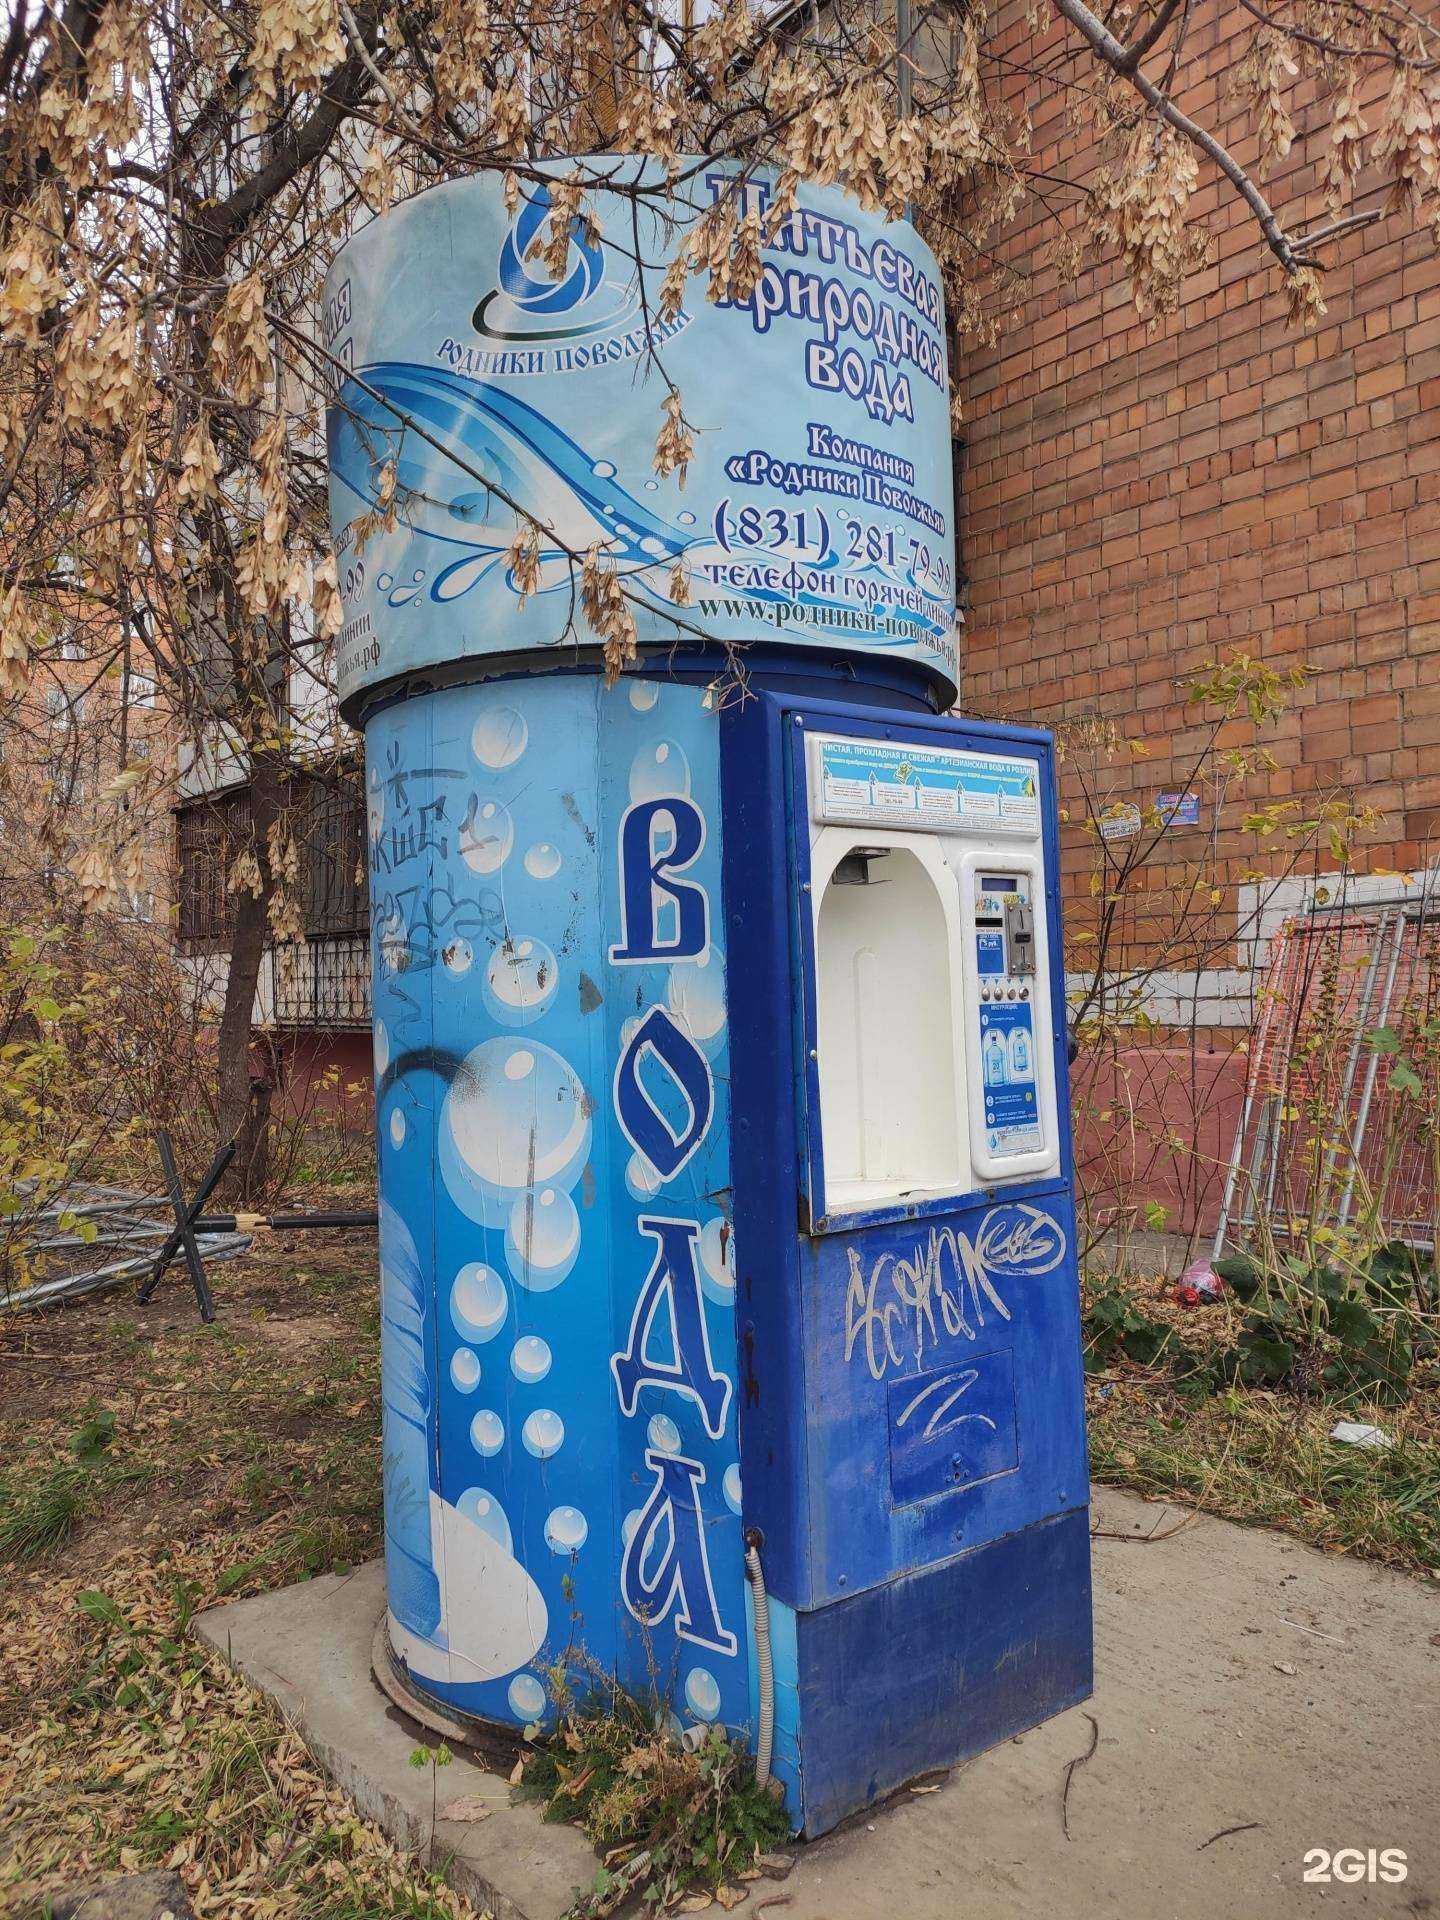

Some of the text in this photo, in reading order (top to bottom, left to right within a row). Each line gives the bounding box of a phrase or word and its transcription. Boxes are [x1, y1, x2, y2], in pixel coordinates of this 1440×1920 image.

[710, 261, 945, 394] риродная
[806, 422, 915, 487] Компания
[703, 561, 836, 599] телефон
[844, 576, 923, 612] горячей
[714, 498, 952, 596] (831) 281-79-99
